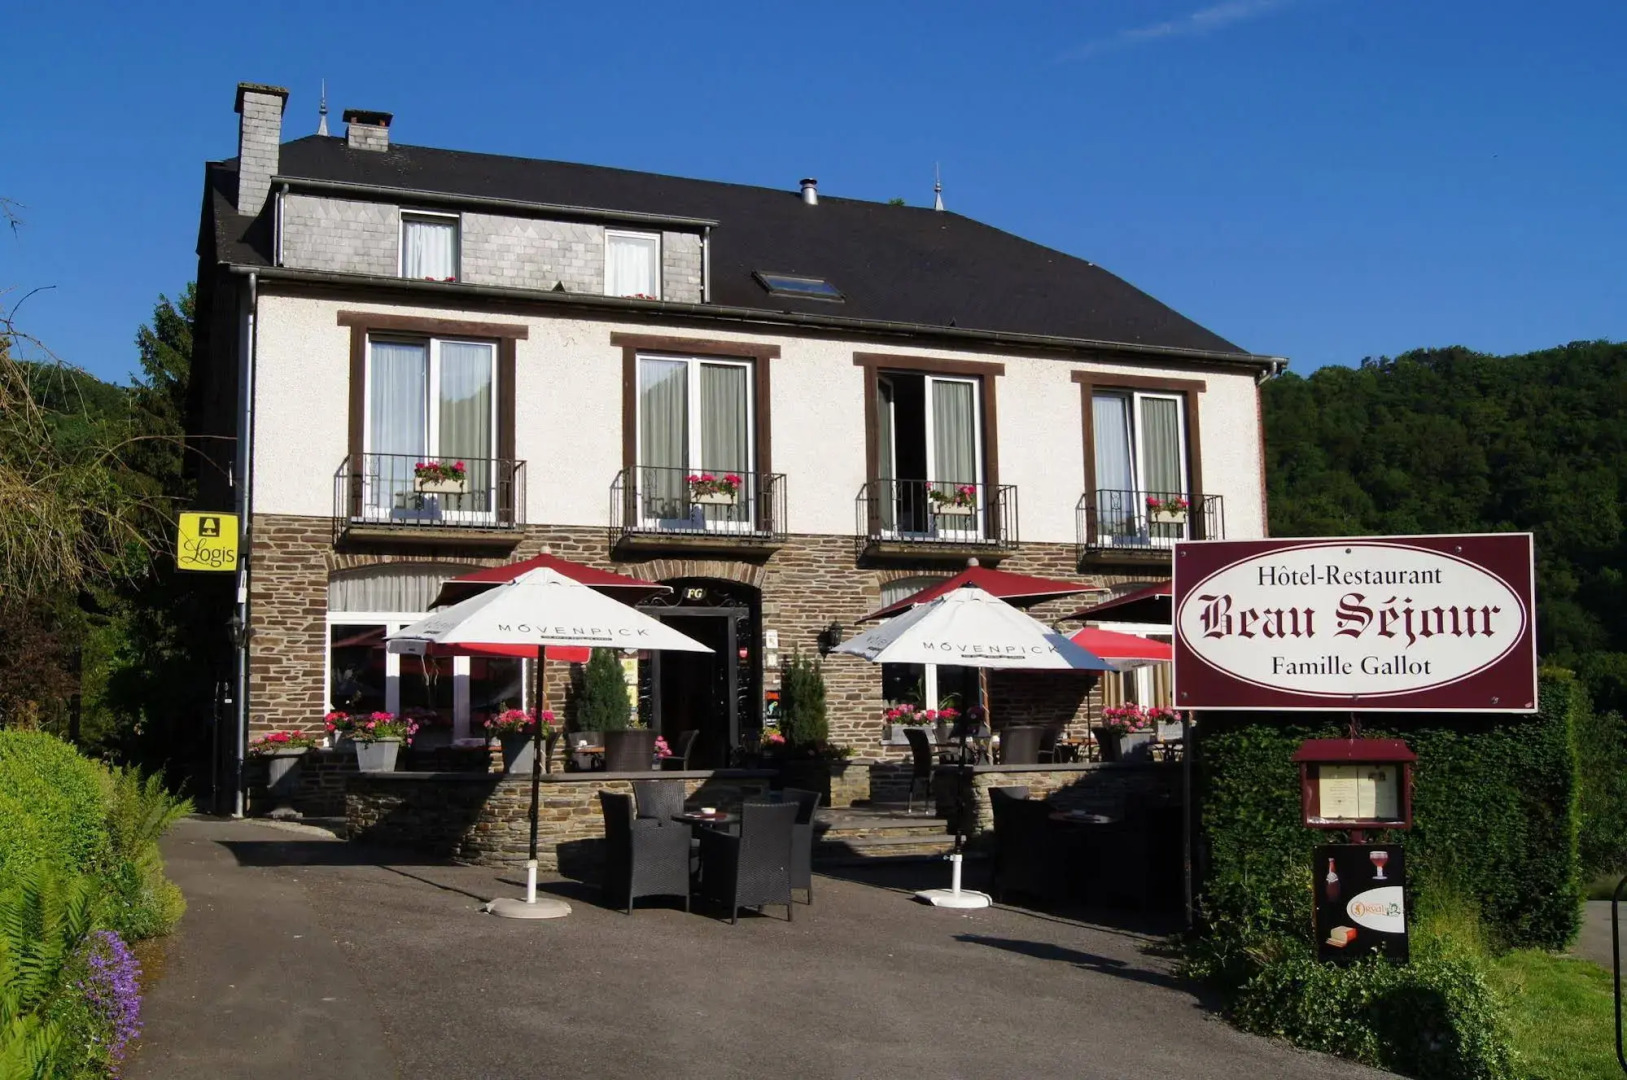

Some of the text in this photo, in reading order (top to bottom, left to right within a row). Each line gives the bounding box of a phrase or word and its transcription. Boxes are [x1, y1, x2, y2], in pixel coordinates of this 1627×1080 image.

[180, 538, 235, 568] Logis
[1257, 565, 1442, 586] Hôtel-Restaurant
[686, 588, 703, 599] FG
[1198, 592, 1501, 649] Beau Séjour
[1272, 656, 1432, 676] Famille Gallot
